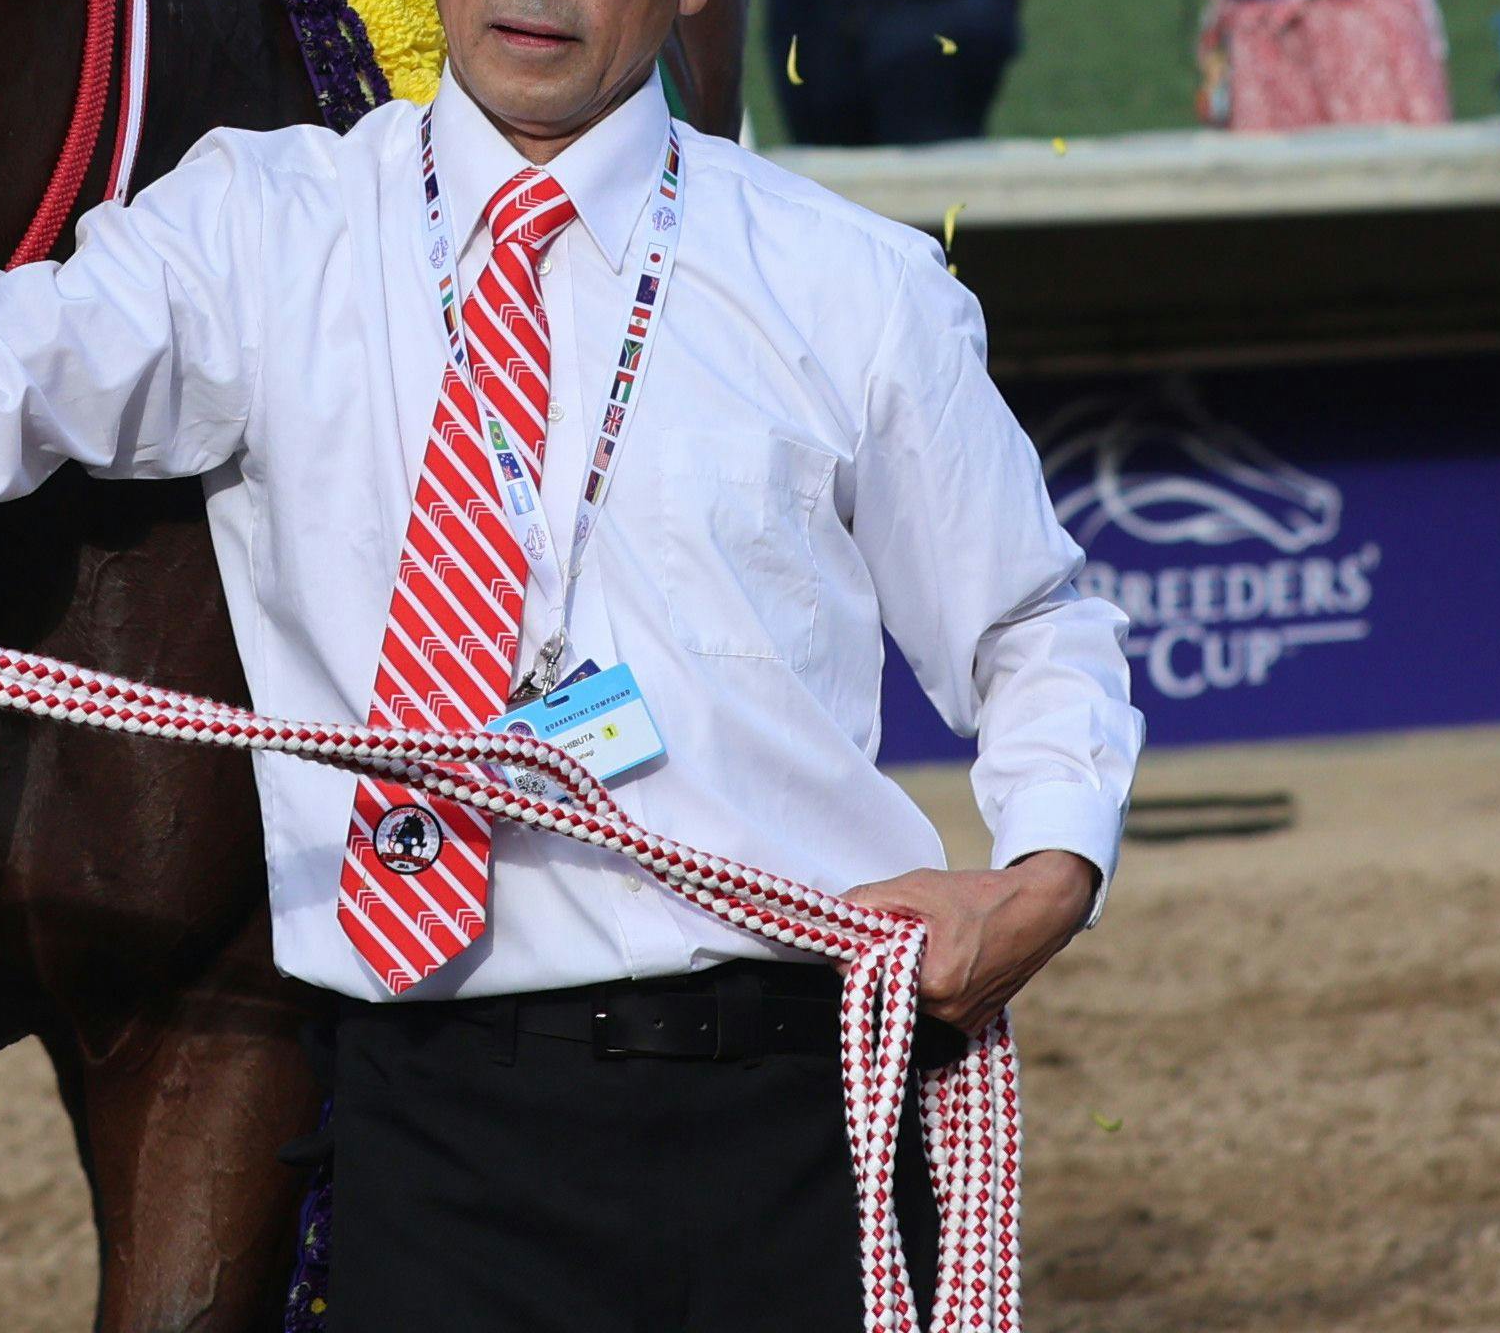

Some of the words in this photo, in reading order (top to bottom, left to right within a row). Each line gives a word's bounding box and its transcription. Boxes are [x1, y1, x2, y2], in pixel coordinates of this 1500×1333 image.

[1149, 627, 1281, 699] CUP
[545, 707, 589, 732] QUARANTINE
[591, 689, 631, 711] COMPOUND
[561, 733, 595, 751] HIBUTA
